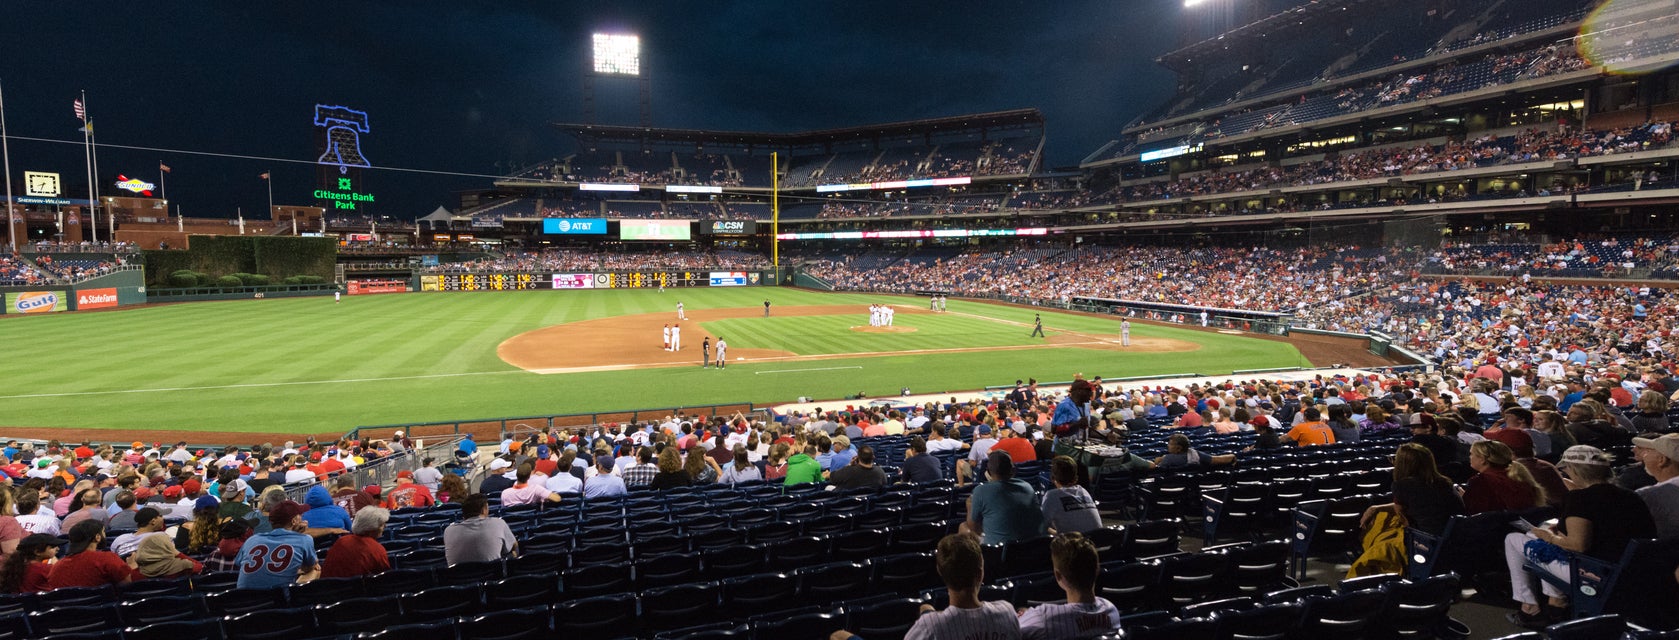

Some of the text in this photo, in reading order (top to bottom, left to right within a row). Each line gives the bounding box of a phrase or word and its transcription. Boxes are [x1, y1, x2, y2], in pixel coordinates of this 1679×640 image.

[119, 182, 153, 190] SUNOCO
[314, 190, 375, 202] Citizens Bank
[335, 201, 356, 210] Park
[572, 222, 592, 231] AT&T
[724, 221, 744, 230] CSN
[18, 295, 55, 309] Gulf
[1323, 431, 1329, 444] 1
[243, 544, 294, 574] 39
[1075, 612, 1112, 632] HOWARD
